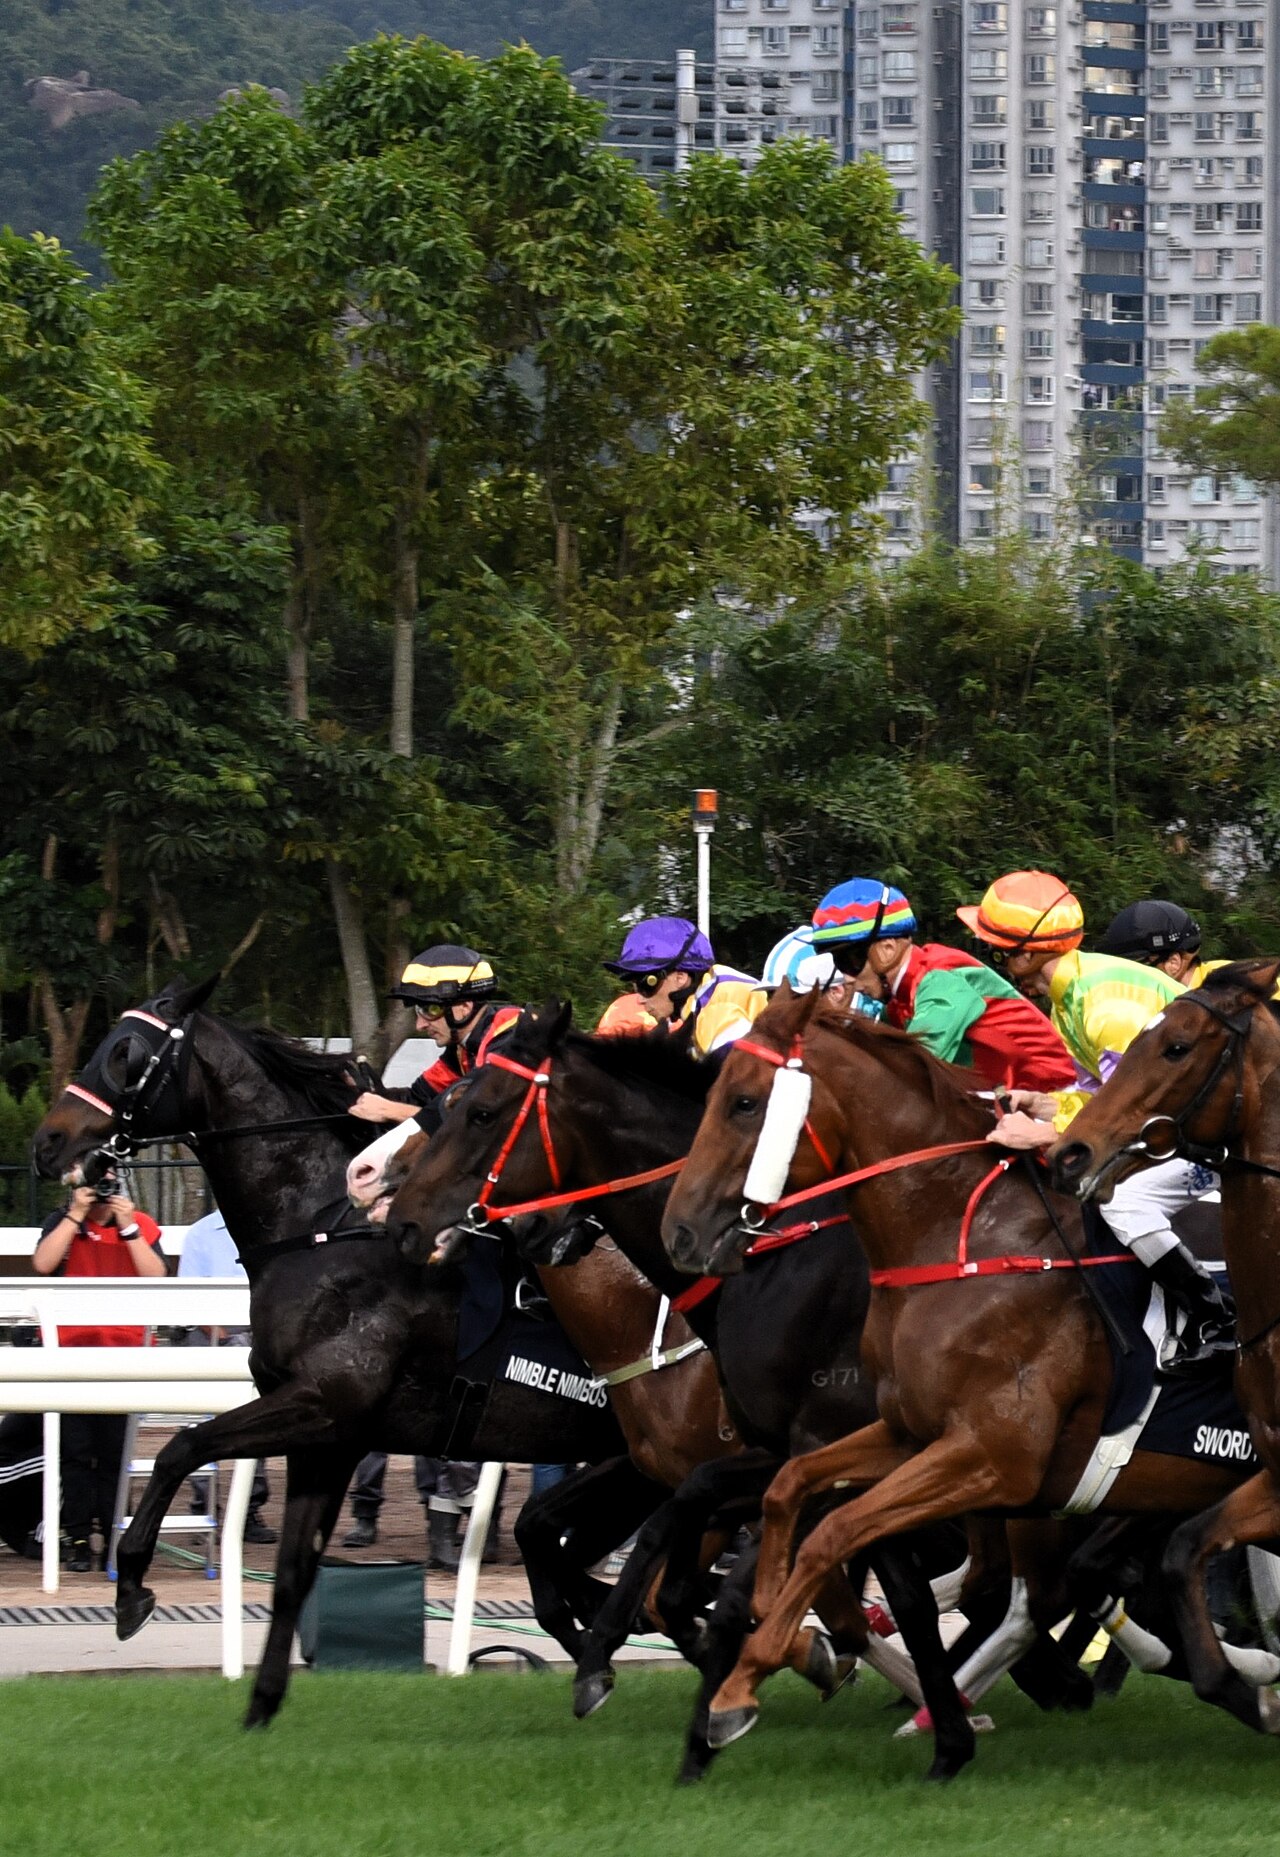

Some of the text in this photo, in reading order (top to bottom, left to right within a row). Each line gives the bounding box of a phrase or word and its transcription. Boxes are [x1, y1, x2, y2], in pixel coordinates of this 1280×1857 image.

[504, 1355, 608, 1408] NIMBLE NIMBUS
[1193, 1424, 1253, 1461] SWORD
